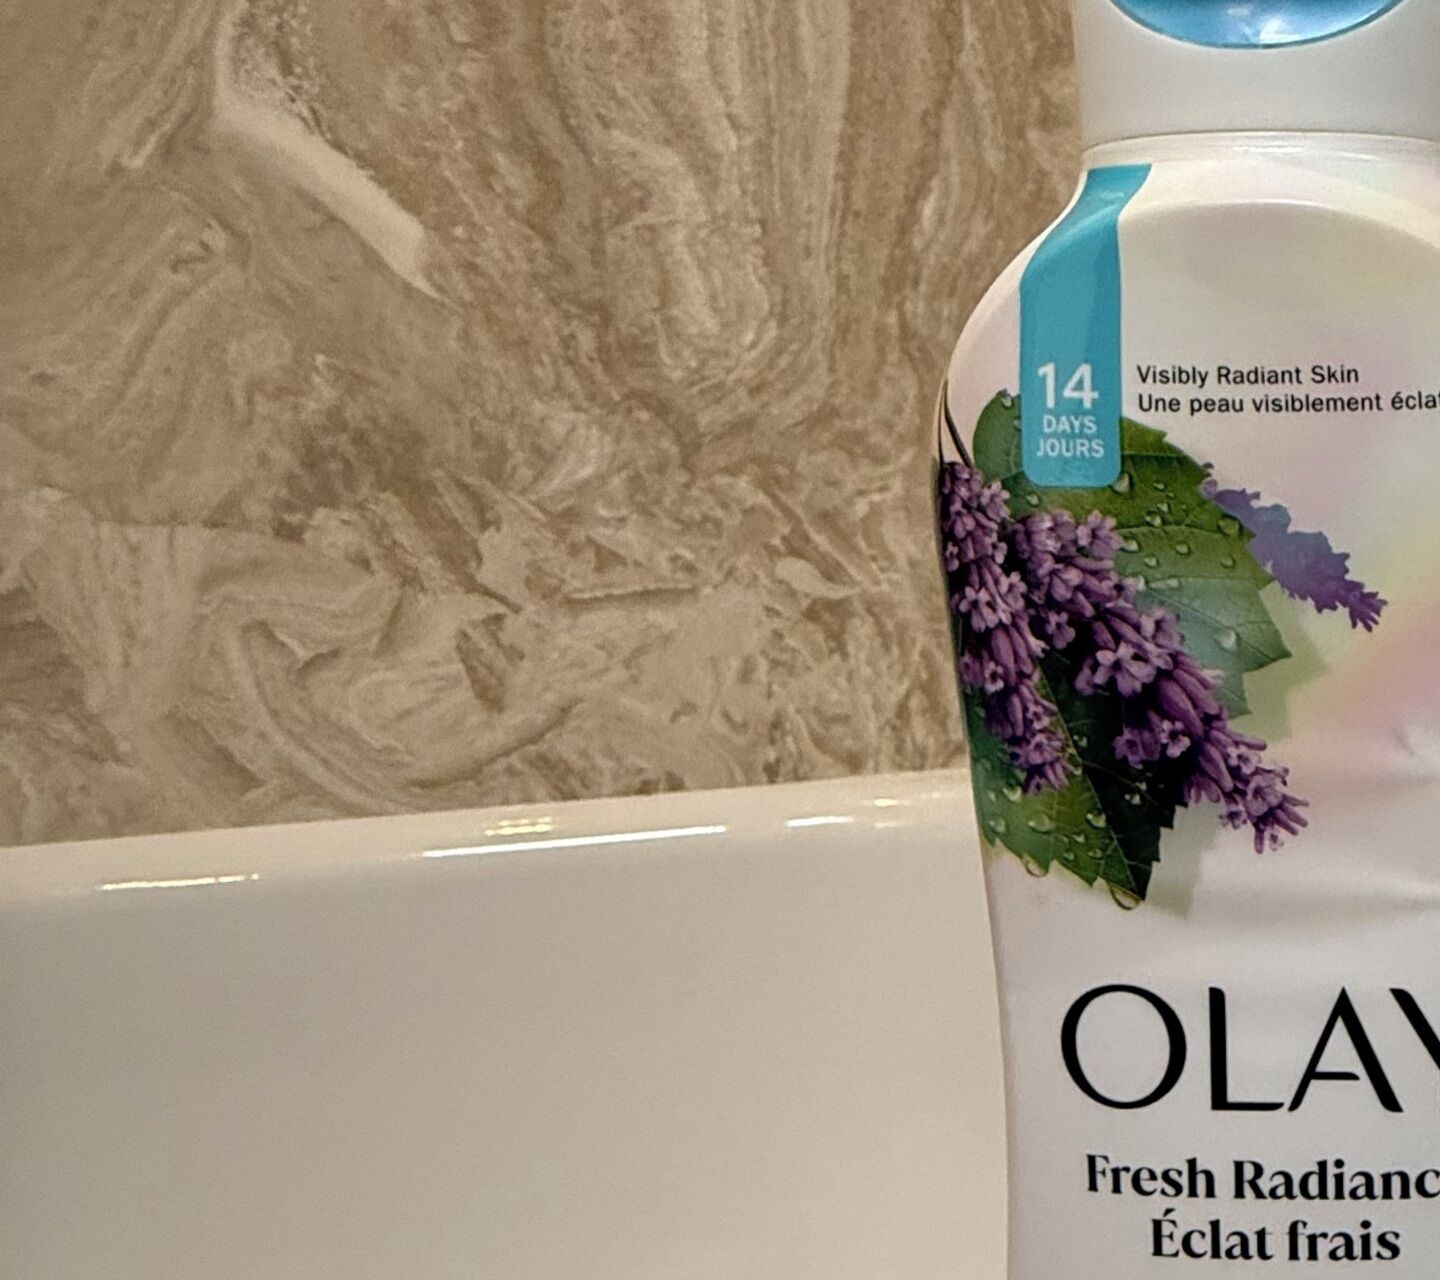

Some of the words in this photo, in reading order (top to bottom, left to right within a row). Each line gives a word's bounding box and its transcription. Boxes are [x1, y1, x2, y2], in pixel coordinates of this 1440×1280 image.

[1038, 362, 1098, 409] 14
[1137, 365, 1208, 389] Visibly
[1217, 365, 1302, 385] Radiant
[1311, 365, 1359, 384] Skin
[1138, 394, 1181, 413] Une
[1190, 398, 1244, 416] peau
[1252, 392, 1383, 413] visiblement
[1043, 416, 1097, 433] DAYS
[1036, 438, 1105, 458] JOURS
[1086, 1154, 1216, 1199] Fresh
[1151, 1208, 1273, 1261] Éclat
[1287, 1220, 1400, 1262] frais
